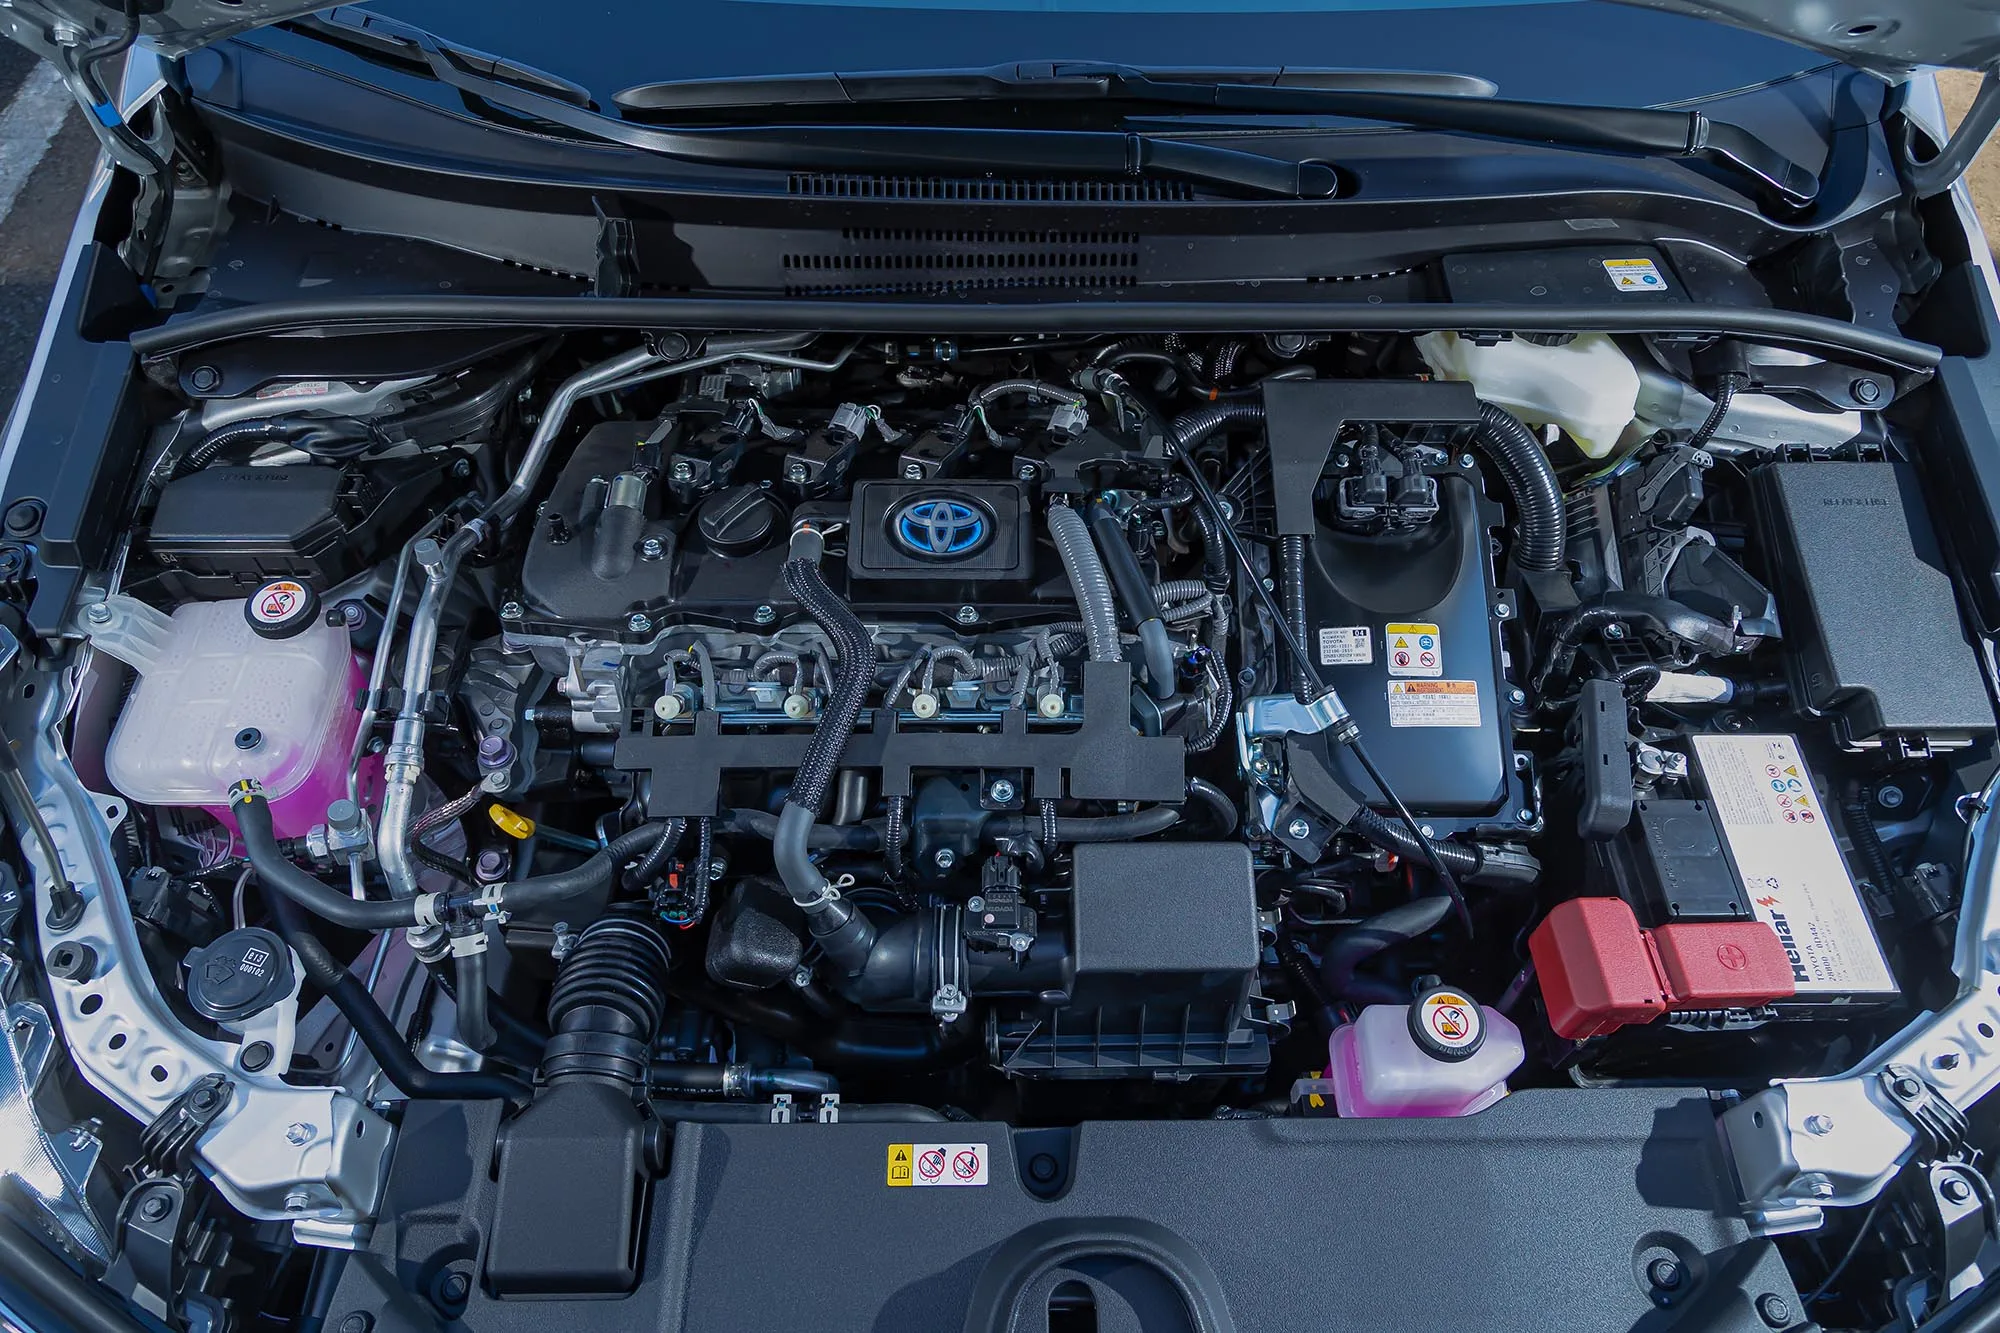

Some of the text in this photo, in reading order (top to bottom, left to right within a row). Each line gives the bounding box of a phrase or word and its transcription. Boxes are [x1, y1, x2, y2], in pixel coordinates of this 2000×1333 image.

[248, 952, 264, 962] e13
[1805, 945, 1825, 981] TOYOTA
[240, 964, 264, 977] 000102
